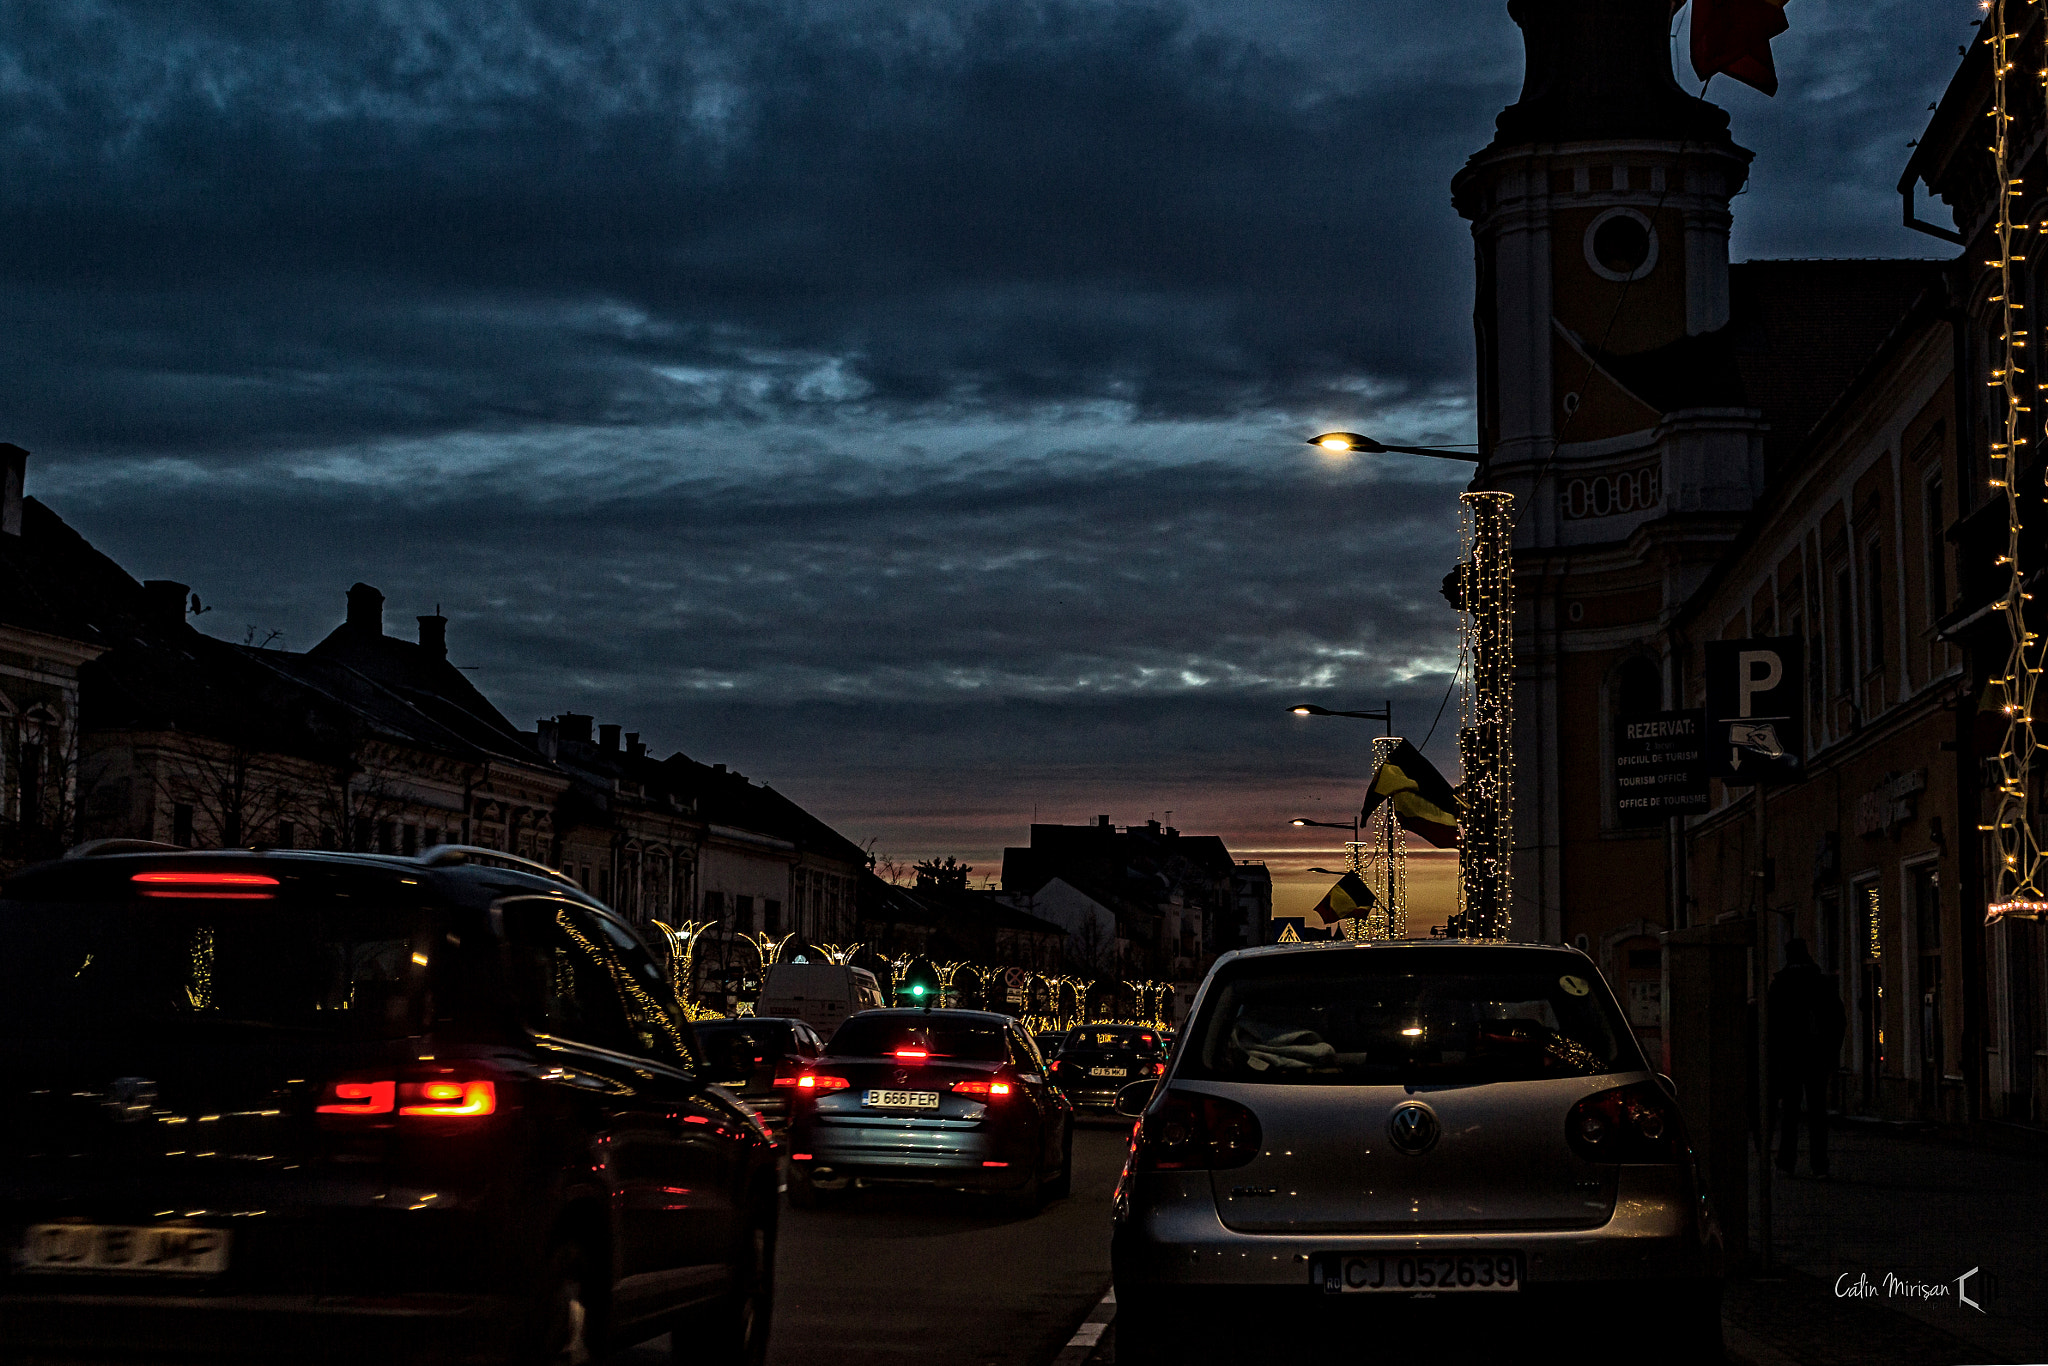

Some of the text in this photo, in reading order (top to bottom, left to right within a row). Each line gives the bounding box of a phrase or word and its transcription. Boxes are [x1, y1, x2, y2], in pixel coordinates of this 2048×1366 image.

[1739, 649, 1783, 718] P
[1627, 718, 1695, 740] REZERVAT:
[1617, 751, 1698, 766] OFICIUL DE TURISM
[1619, 772, 1688, 787] TOURISM OFFICE
[1619, 794, 1707, 808] OFFICE DE TOURISME
[870, 1091, 879, 1104] B
[1345, 1258, 1385, 1289] CJ
[1397, 1257, 1515, 1288] 052639
